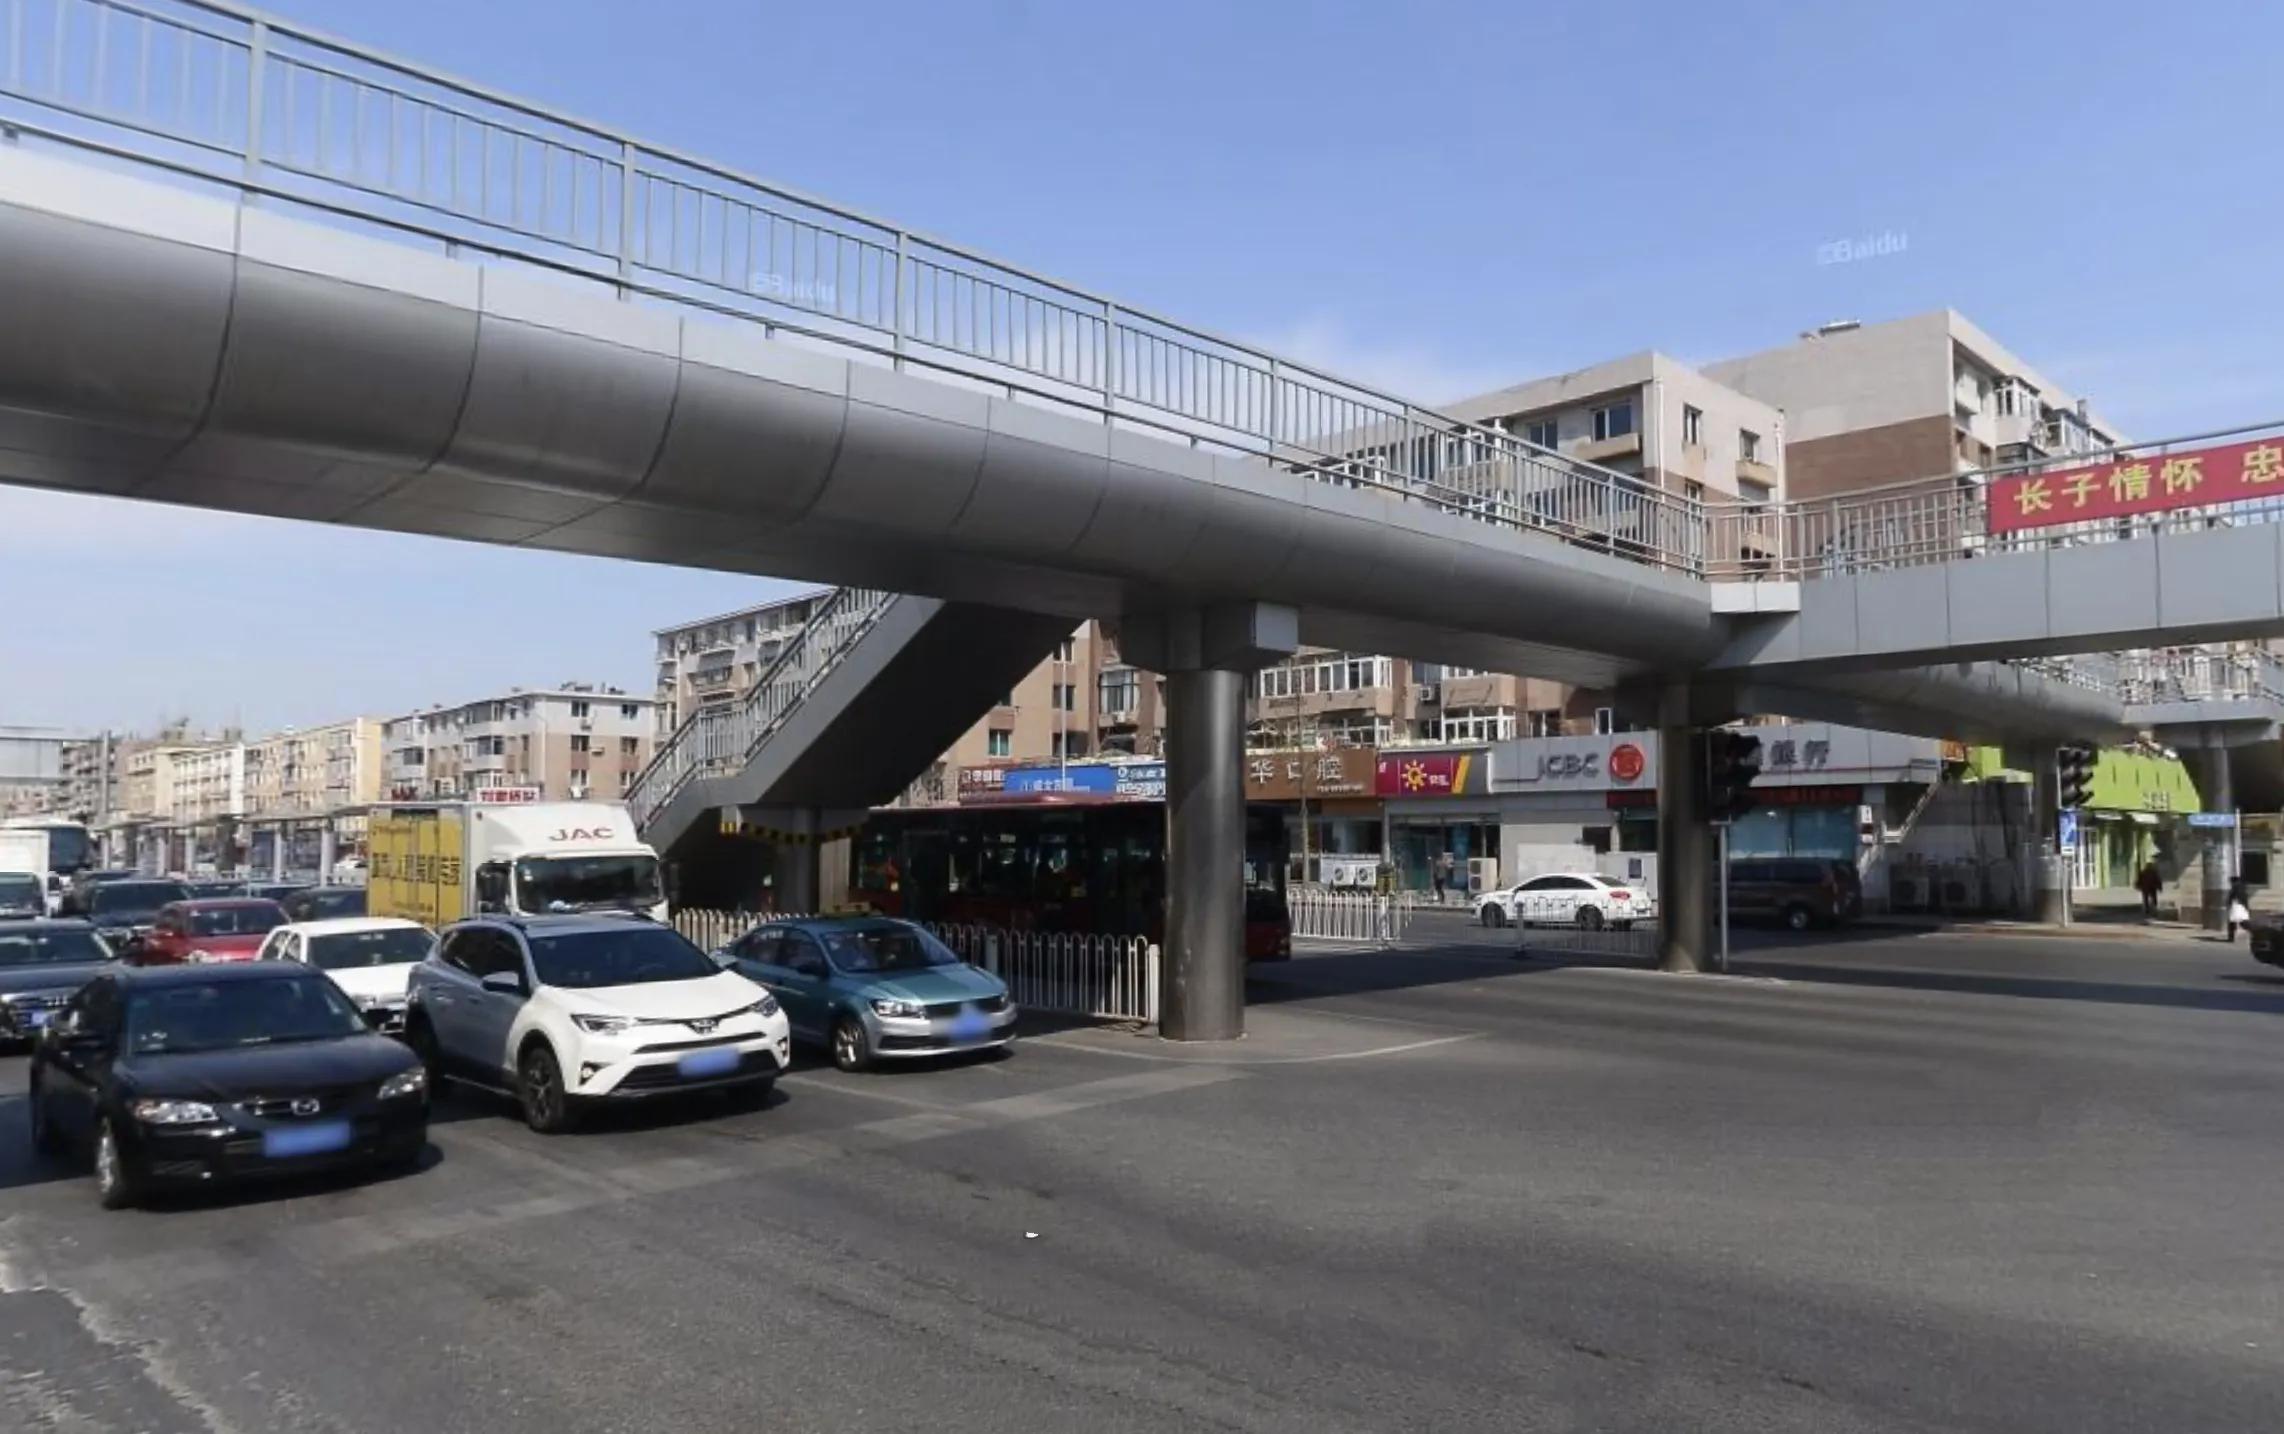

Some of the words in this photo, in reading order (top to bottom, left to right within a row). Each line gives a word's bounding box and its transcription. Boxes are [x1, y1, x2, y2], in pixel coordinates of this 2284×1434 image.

[2013, 457, 2204, 515] 长子情怀
[2240, 444, 2284, 483] 忠
[548, 828, 615, 842] JAC
